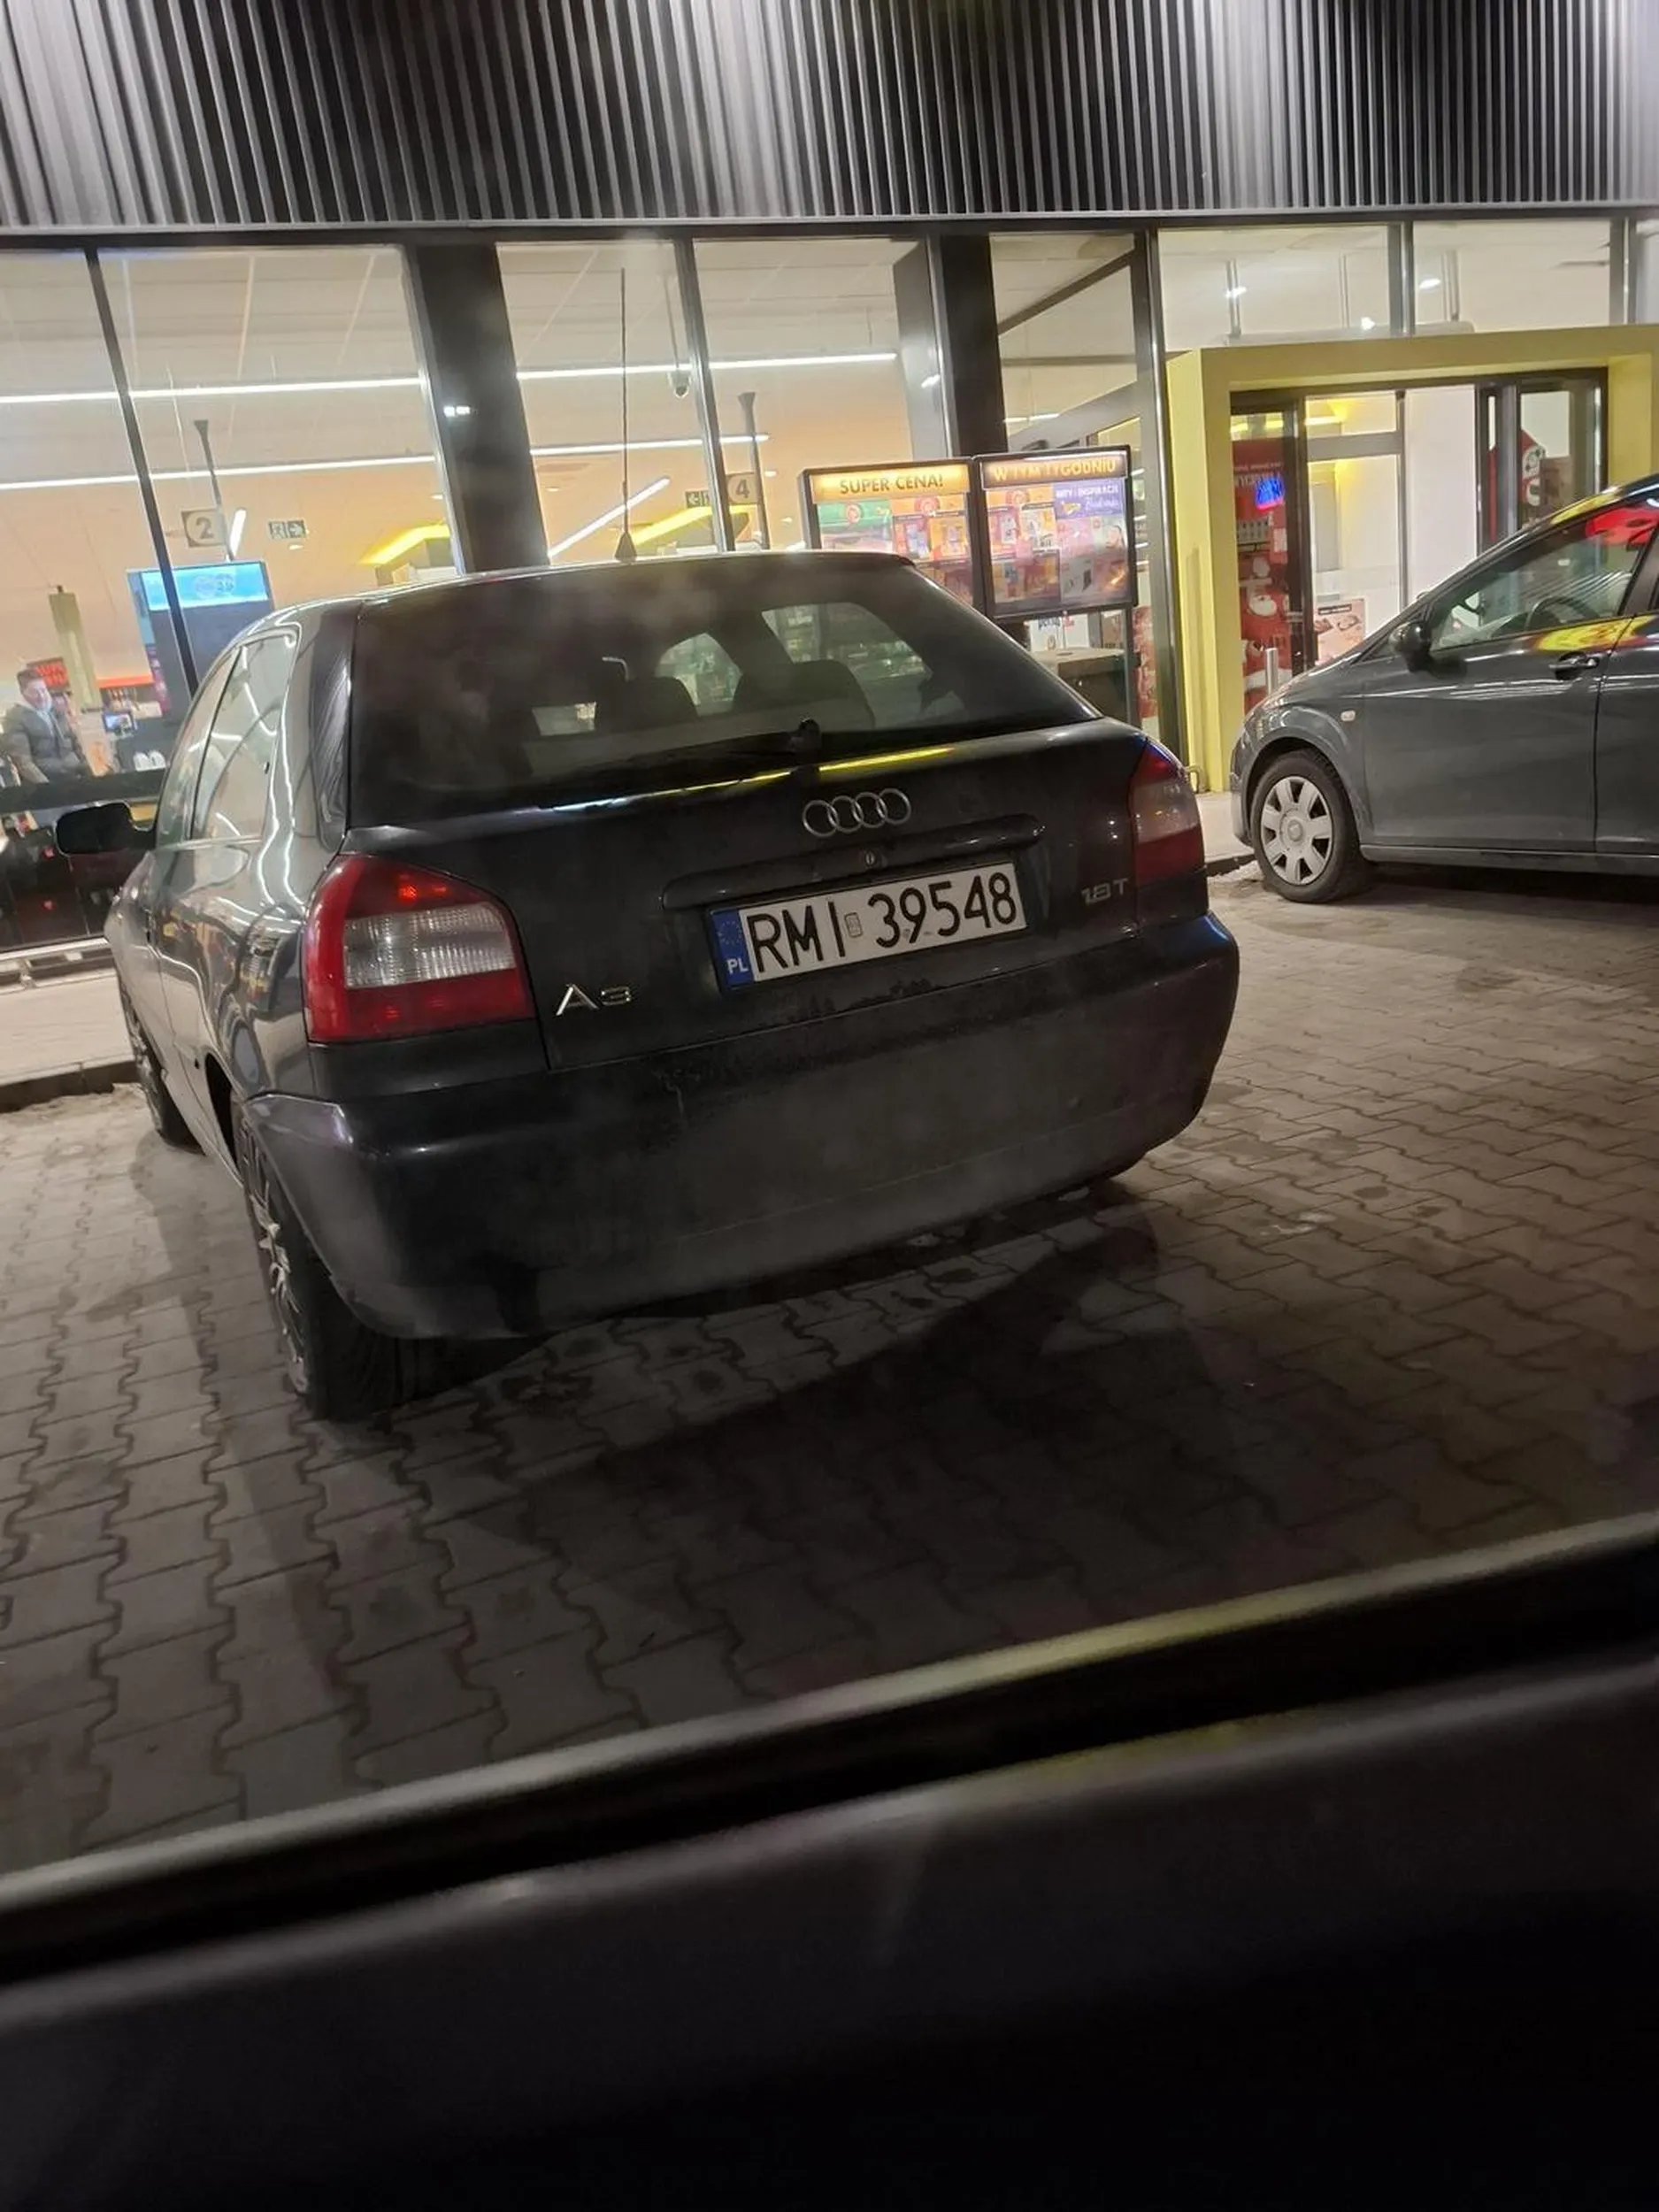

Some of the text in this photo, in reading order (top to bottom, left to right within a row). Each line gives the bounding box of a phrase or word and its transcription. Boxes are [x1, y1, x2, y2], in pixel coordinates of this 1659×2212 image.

[735, 479, 750, 498] 4
[840, 474, 944, 494] SUPER CENA!
[195, 517, 215, 540] 2
[747, 872, 1018, 973] RMI 39548
[727, 958, 750, 974] PL
[555, 983, 632, 1017] A3
